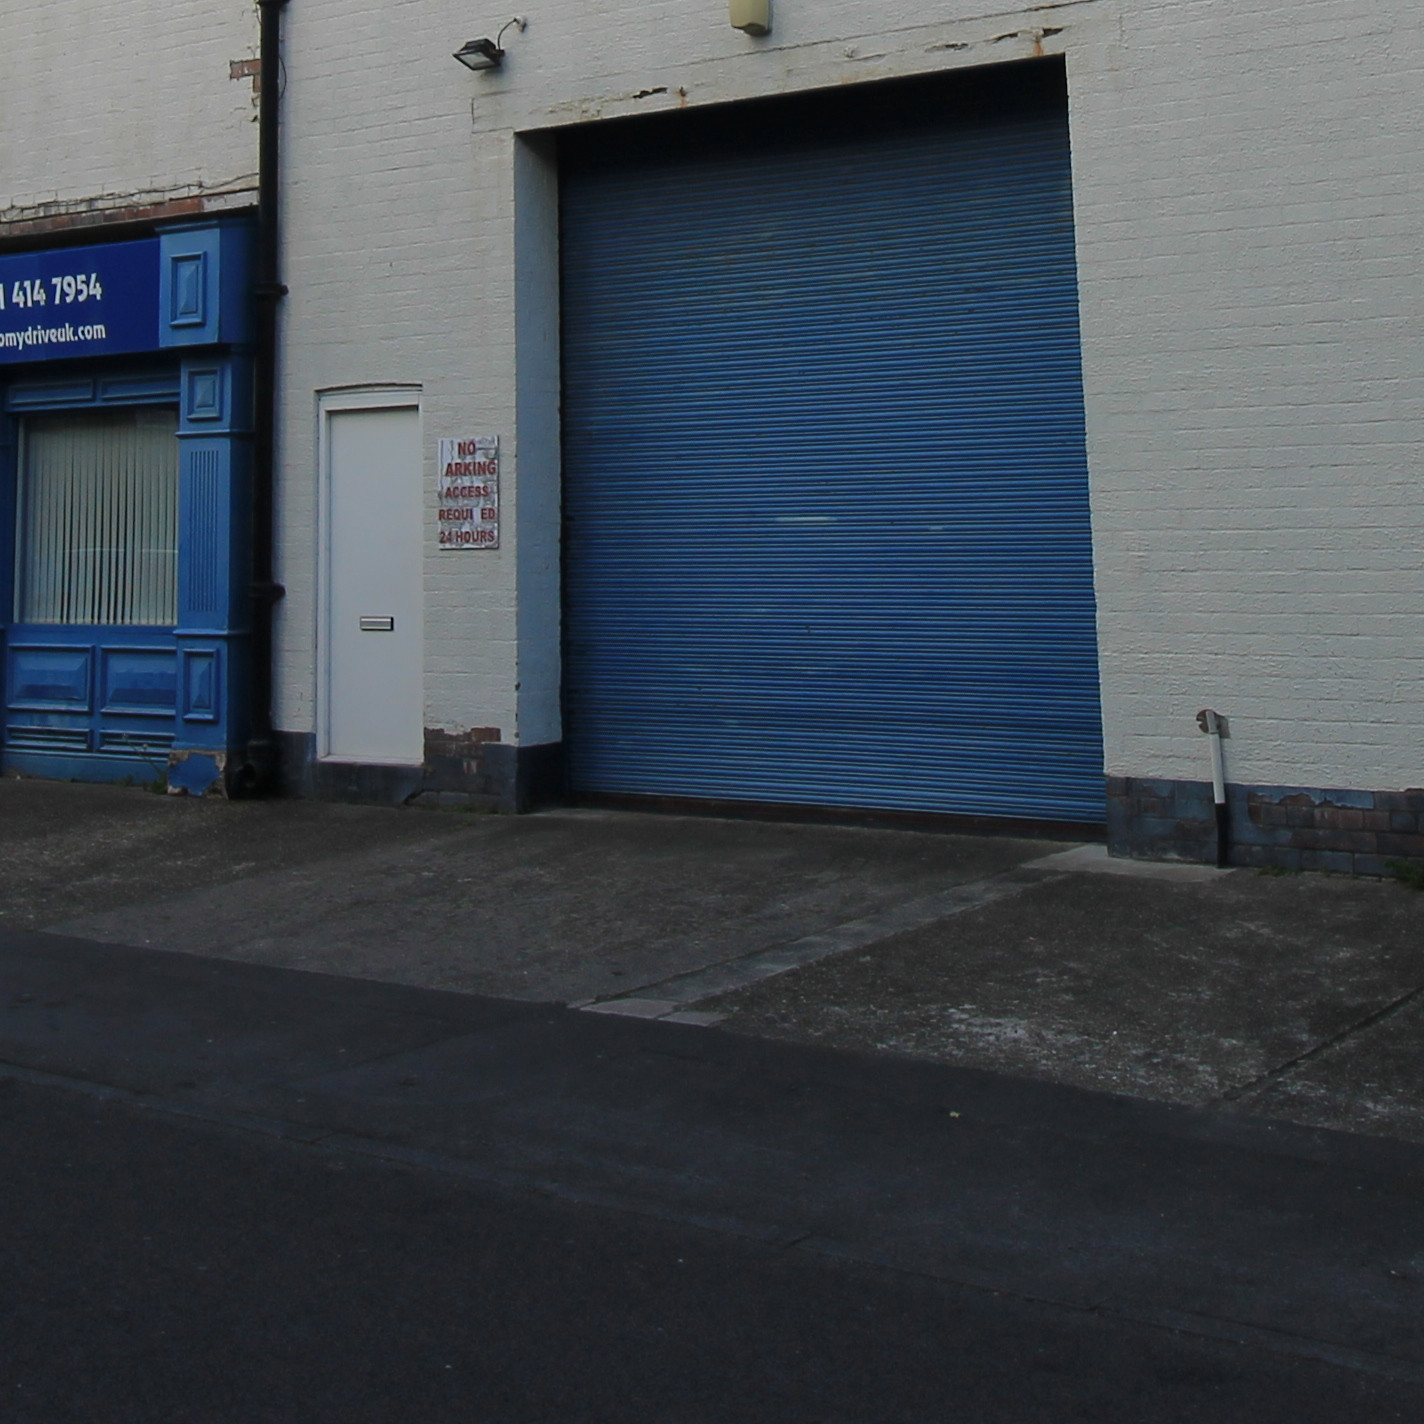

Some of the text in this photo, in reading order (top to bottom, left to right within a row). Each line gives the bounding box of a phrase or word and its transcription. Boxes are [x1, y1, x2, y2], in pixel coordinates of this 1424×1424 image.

[12, 279, 46, 308] 414
[51, 273, 102, 305] 7954
[457, 441, 476, 455] NO
[445, 485, 489, 499] ACCESS
[439, 508, 495, 521] REQUIED
[439, 531, 495, 544] 24 HOURS
